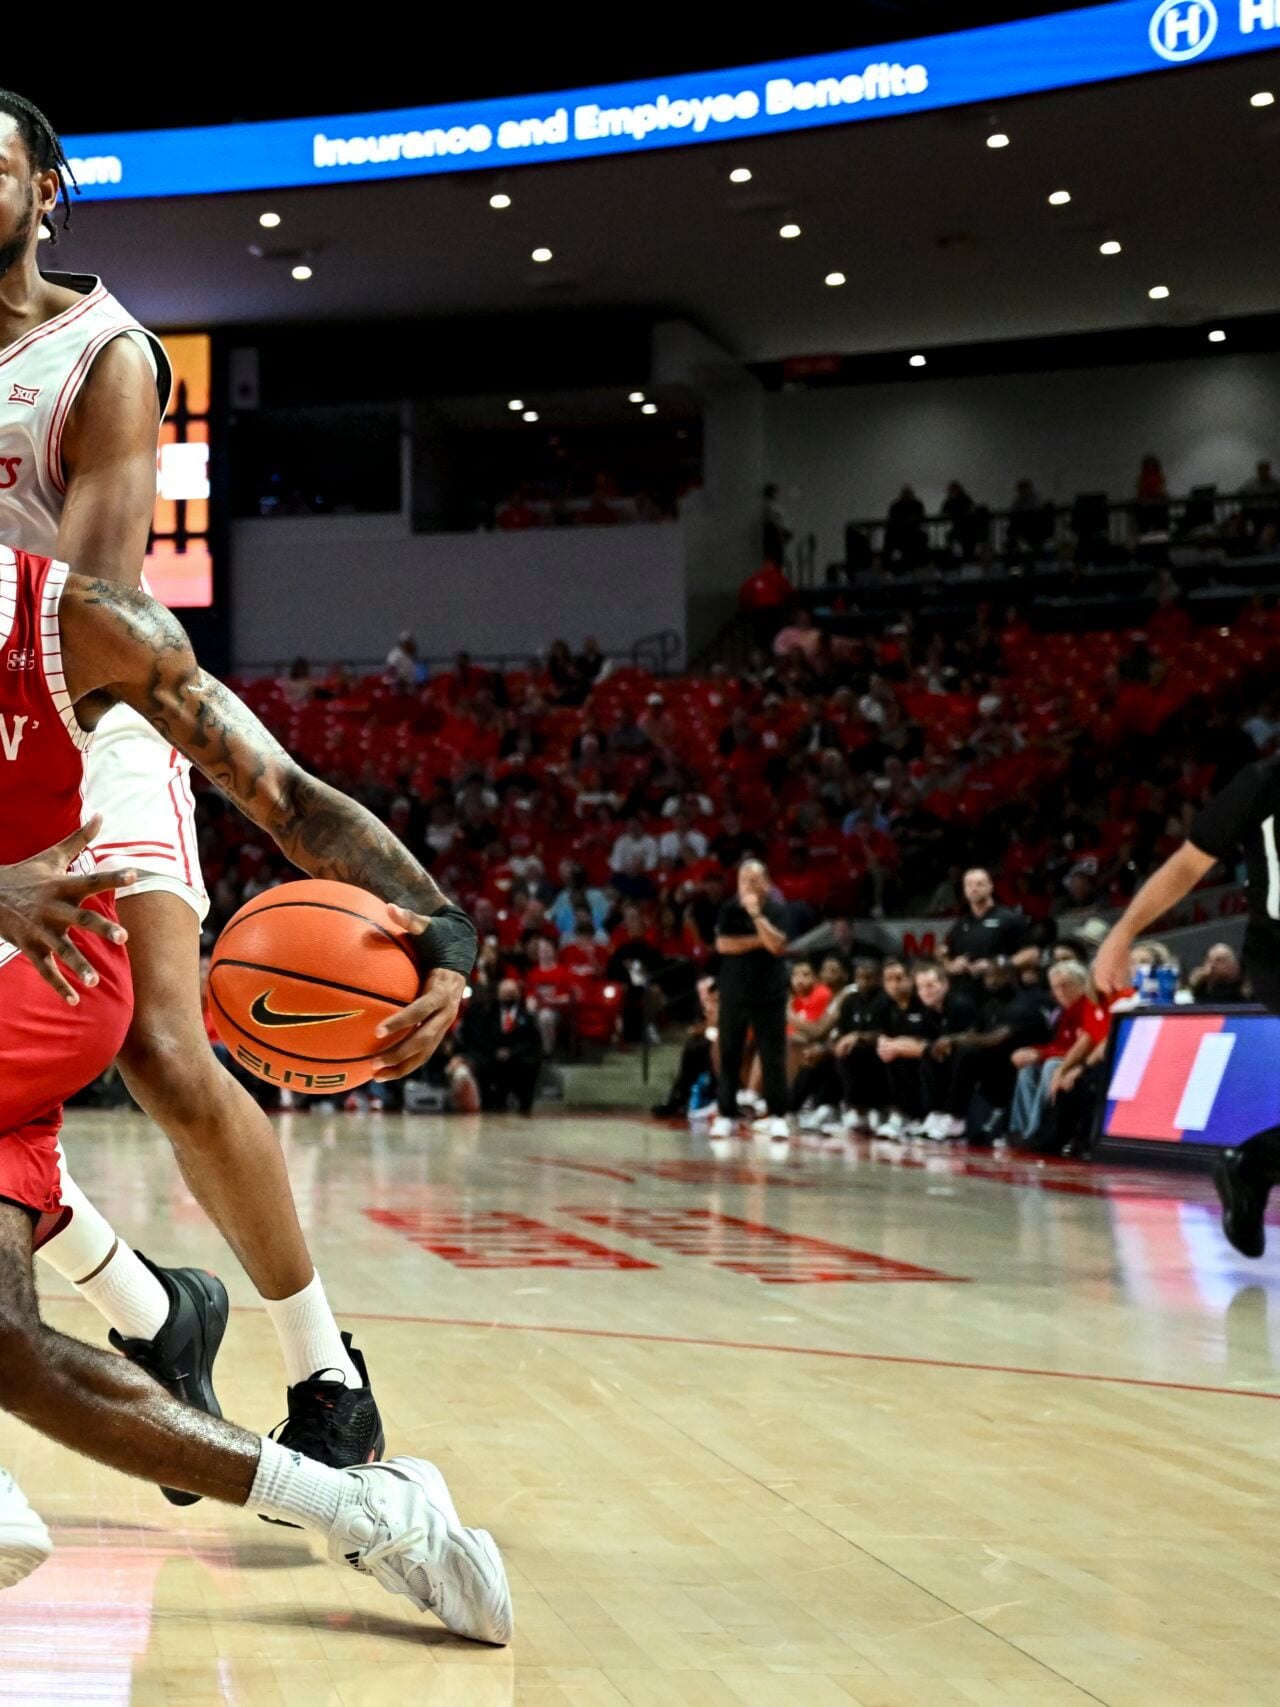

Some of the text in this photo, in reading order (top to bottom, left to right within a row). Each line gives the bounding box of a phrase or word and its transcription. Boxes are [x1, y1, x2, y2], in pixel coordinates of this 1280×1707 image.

[314, 62, 928, 168] Insurance and Employee Benefits
[237, 1043, 348, 1089] ELITE
